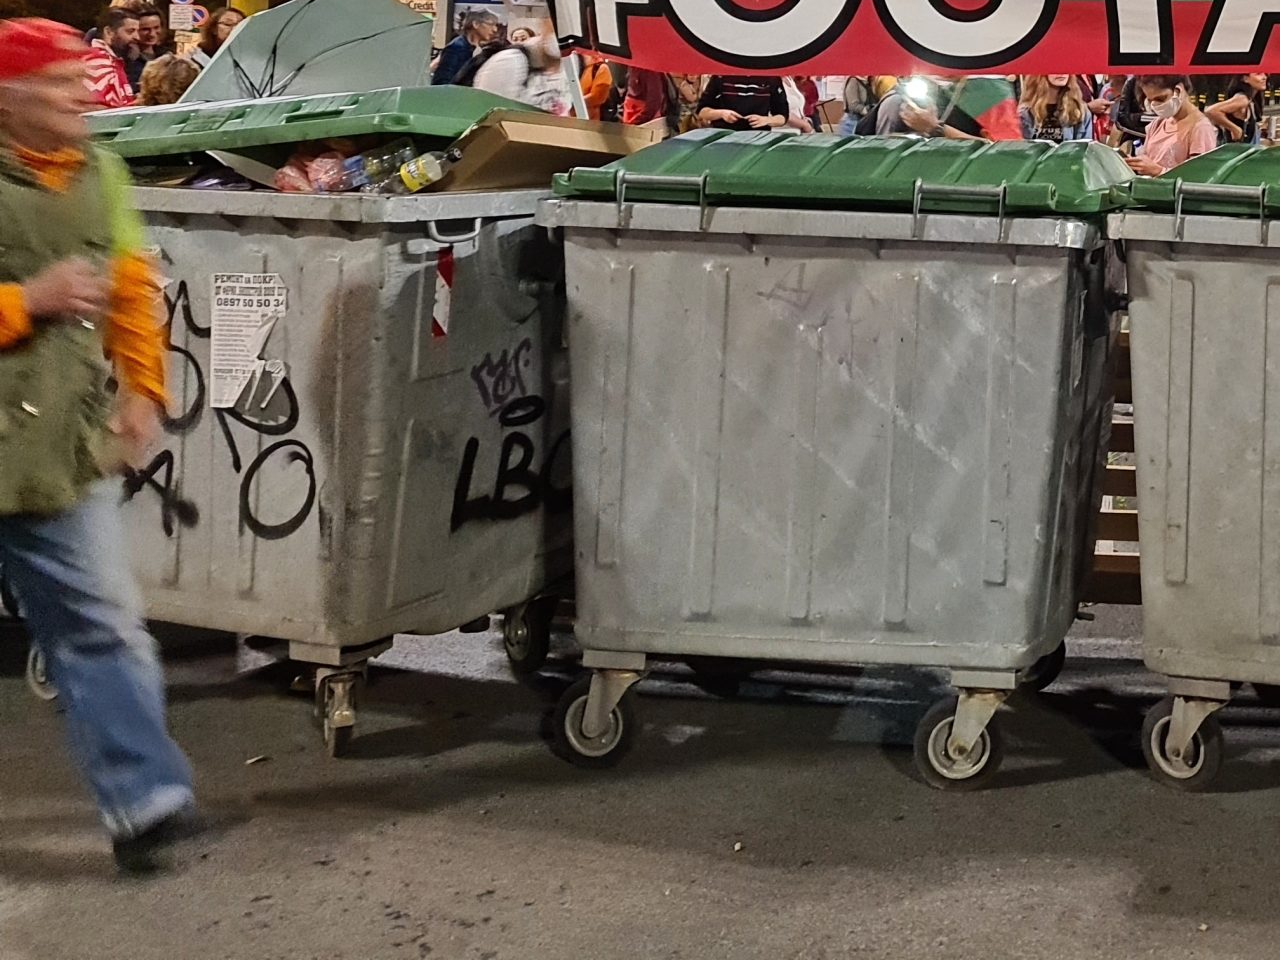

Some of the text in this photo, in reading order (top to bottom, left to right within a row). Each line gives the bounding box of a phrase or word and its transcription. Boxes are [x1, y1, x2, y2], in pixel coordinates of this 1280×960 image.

[216, 297, 241, 307] 0897
[243, 298, 254, 307] 50
[256, 298, 271, 308] 50
